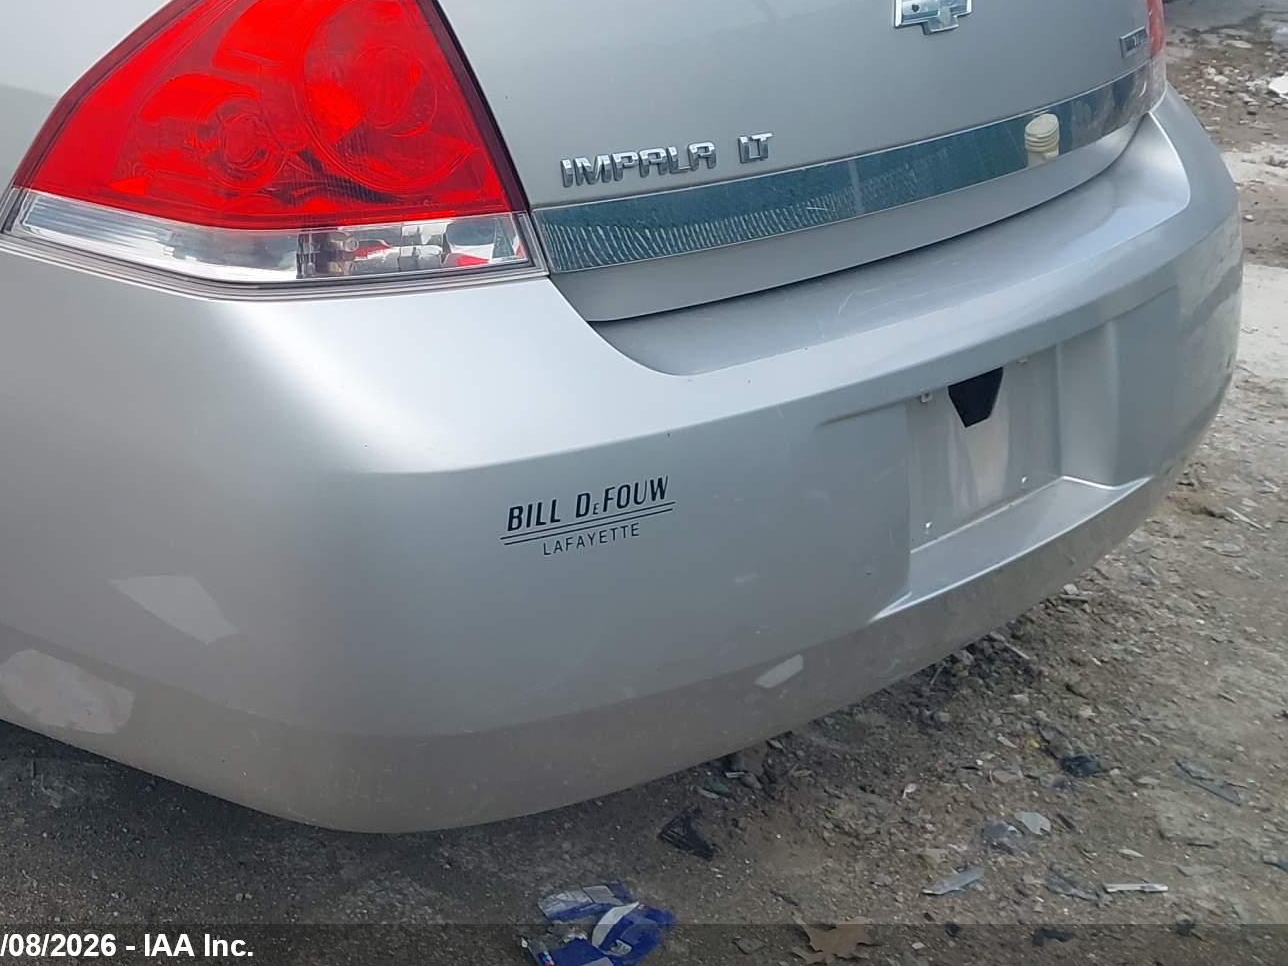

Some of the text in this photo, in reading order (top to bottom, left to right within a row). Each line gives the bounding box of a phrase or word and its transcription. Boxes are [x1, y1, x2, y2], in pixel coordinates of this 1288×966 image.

[560, 132, 774, 188] IMPALA LT
[507, 498, 561, 532] BILL
[543, 522, 640, 556] LAFAYETTE
